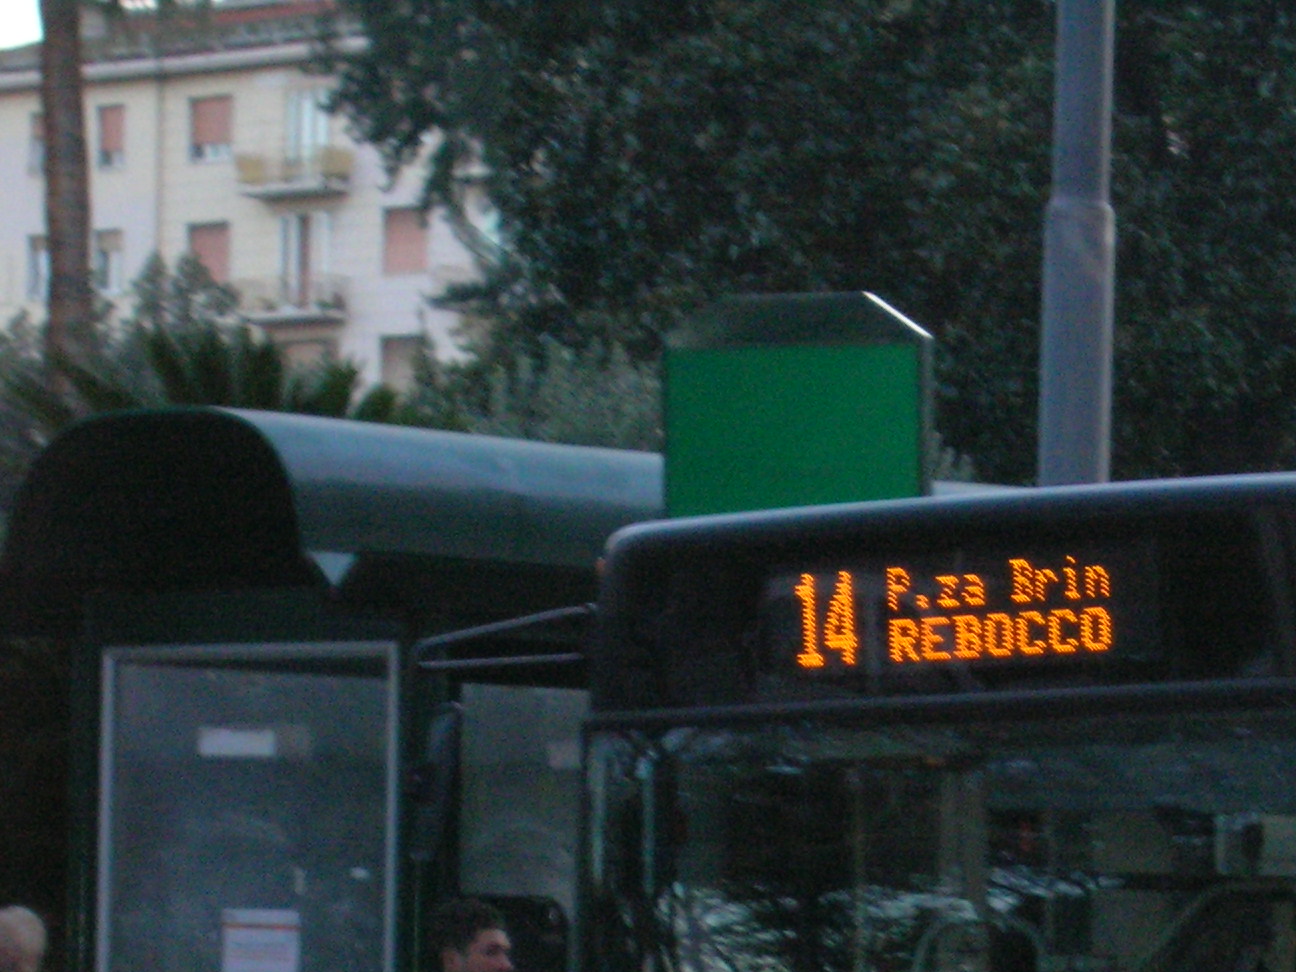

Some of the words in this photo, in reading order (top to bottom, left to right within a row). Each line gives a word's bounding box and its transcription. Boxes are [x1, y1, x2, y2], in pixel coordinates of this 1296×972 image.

[886, 566, 987, 612] P.za
[1008, 554, 1112, 604] Brin
[795, 570, 858, 669] 14
[888, 606, 1113, 663] REBOCCO
